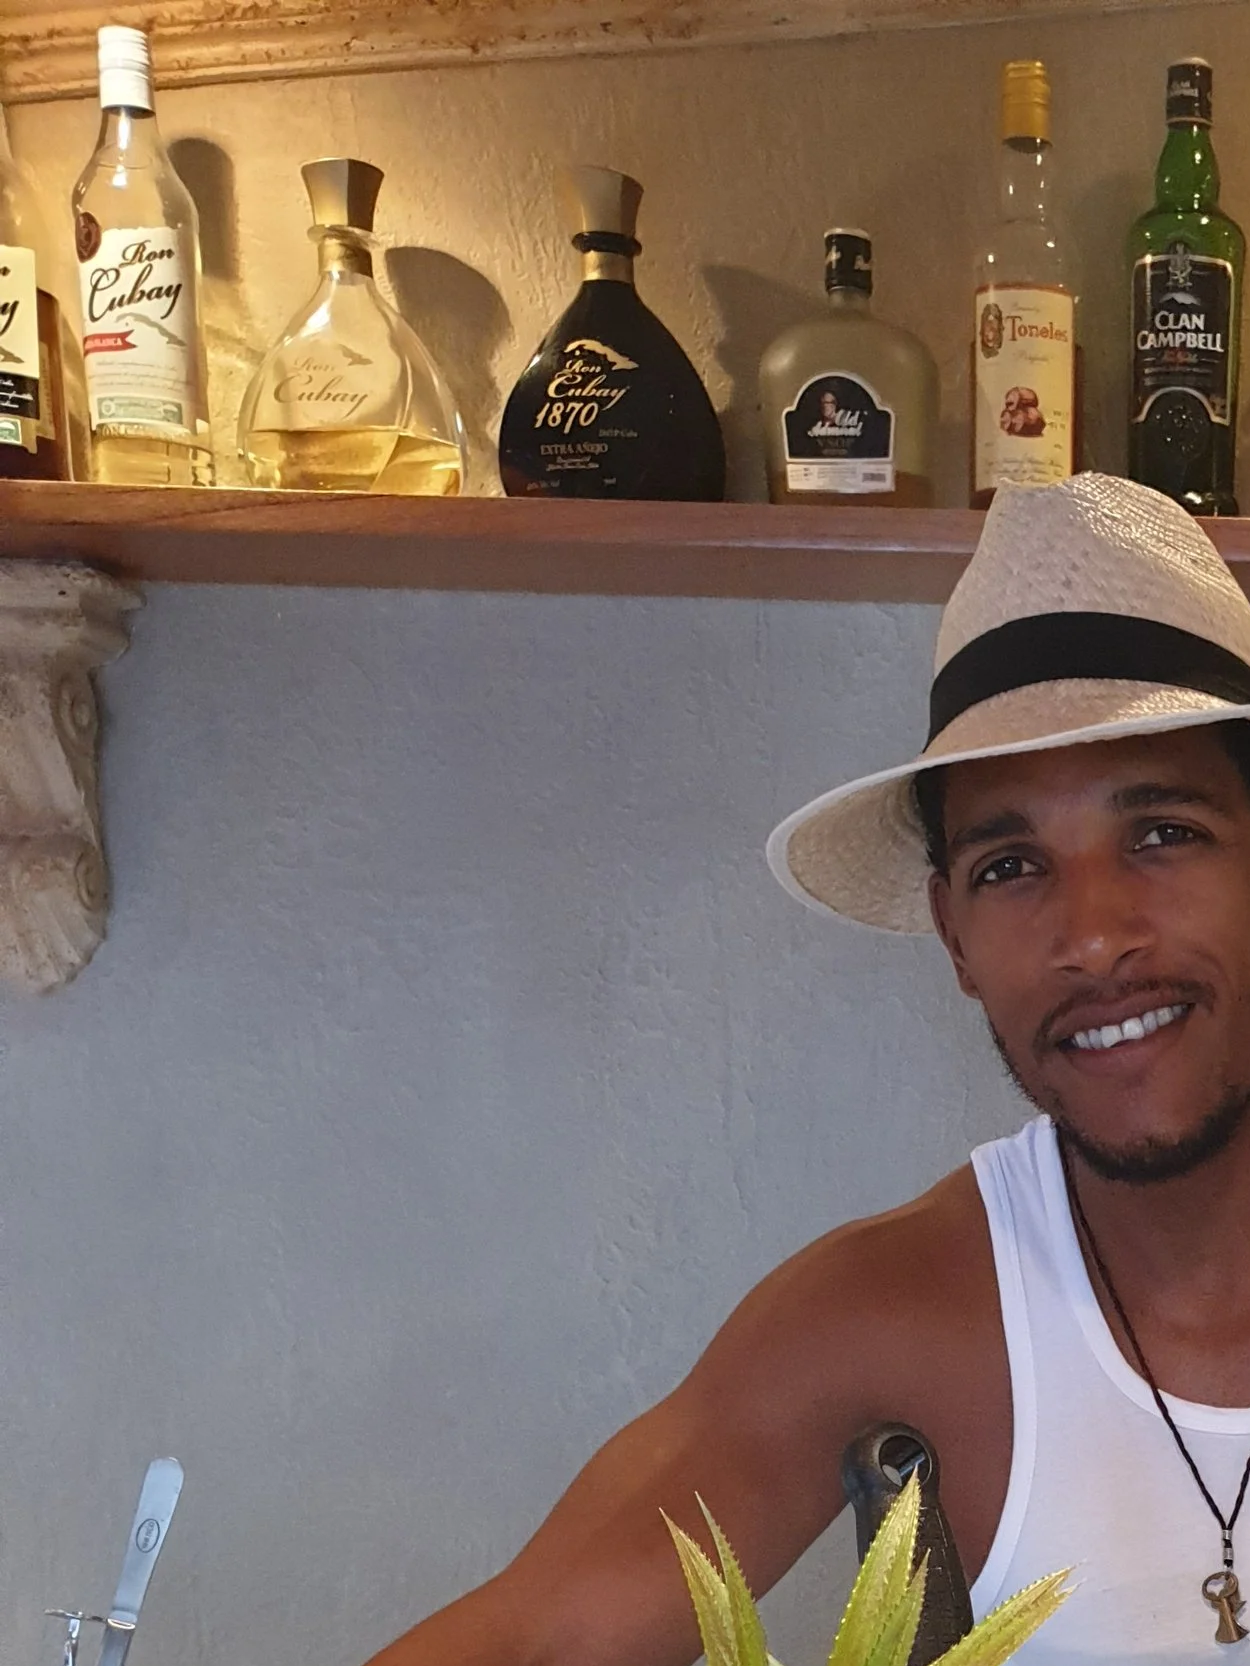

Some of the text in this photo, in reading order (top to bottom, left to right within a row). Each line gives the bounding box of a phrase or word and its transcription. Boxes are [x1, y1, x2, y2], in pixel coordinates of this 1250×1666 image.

[119, 240, 175, 268] Ron
[89, 264, 183, 323] Cubay
[1005, 315, 1069, 342] Toneles
[1154, 310, 1205, 331] CLAN
[1136, 330, 1225, 352] CAMPBELL
[561, 359, 602, 374] Ron
[273, 374, 369, 420] Cubay
[547, 372, 631, 411] Cubay
[533, 401, 599, 434] 1870
[834, 408, 861, 427] Old
[540, 443, 574, 455] EXTRA
